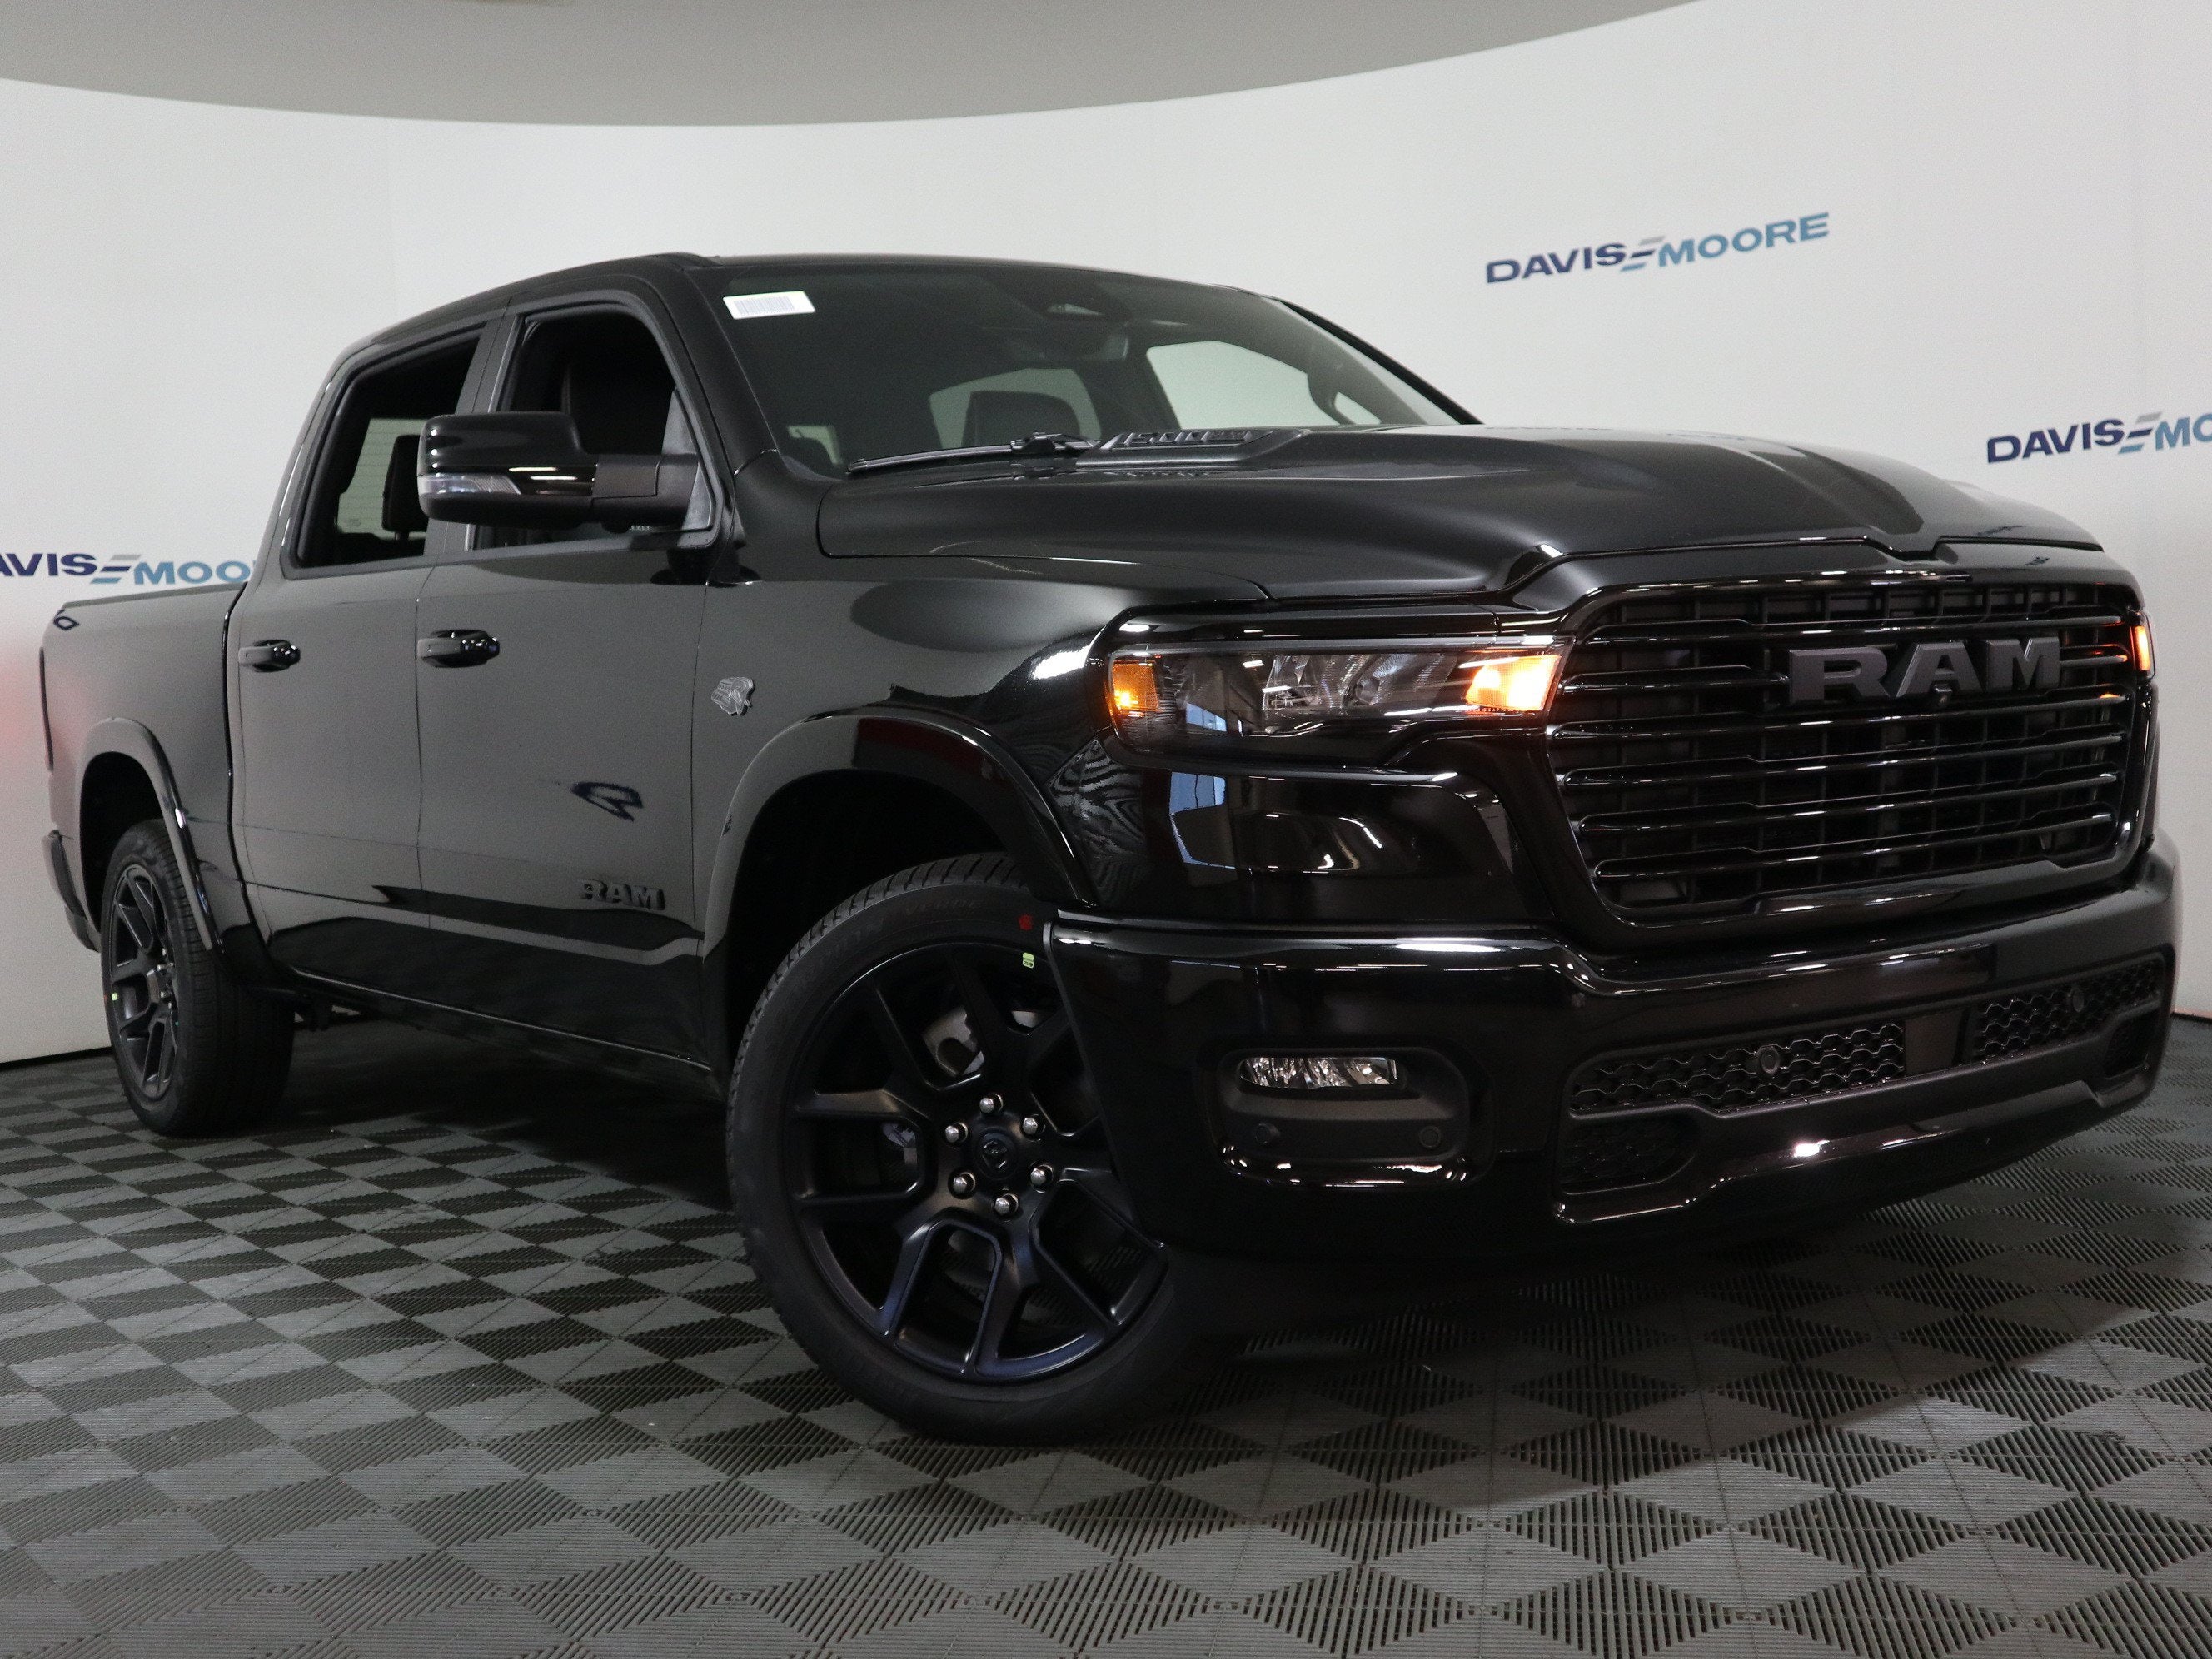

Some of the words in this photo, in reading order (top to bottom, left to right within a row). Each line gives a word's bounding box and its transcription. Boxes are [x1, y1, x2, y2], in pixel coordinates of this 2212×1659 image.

[1486, 242, 1626, 284] DAVIS
[1658, 212, 1830, 267] MOORE
[1986, 418, 2125, 464] DAVIS
[133, 560, 257, 585] MOO
[1788, 635, 2061, 704] RAM
[579, 878, 666, 911] RAM
